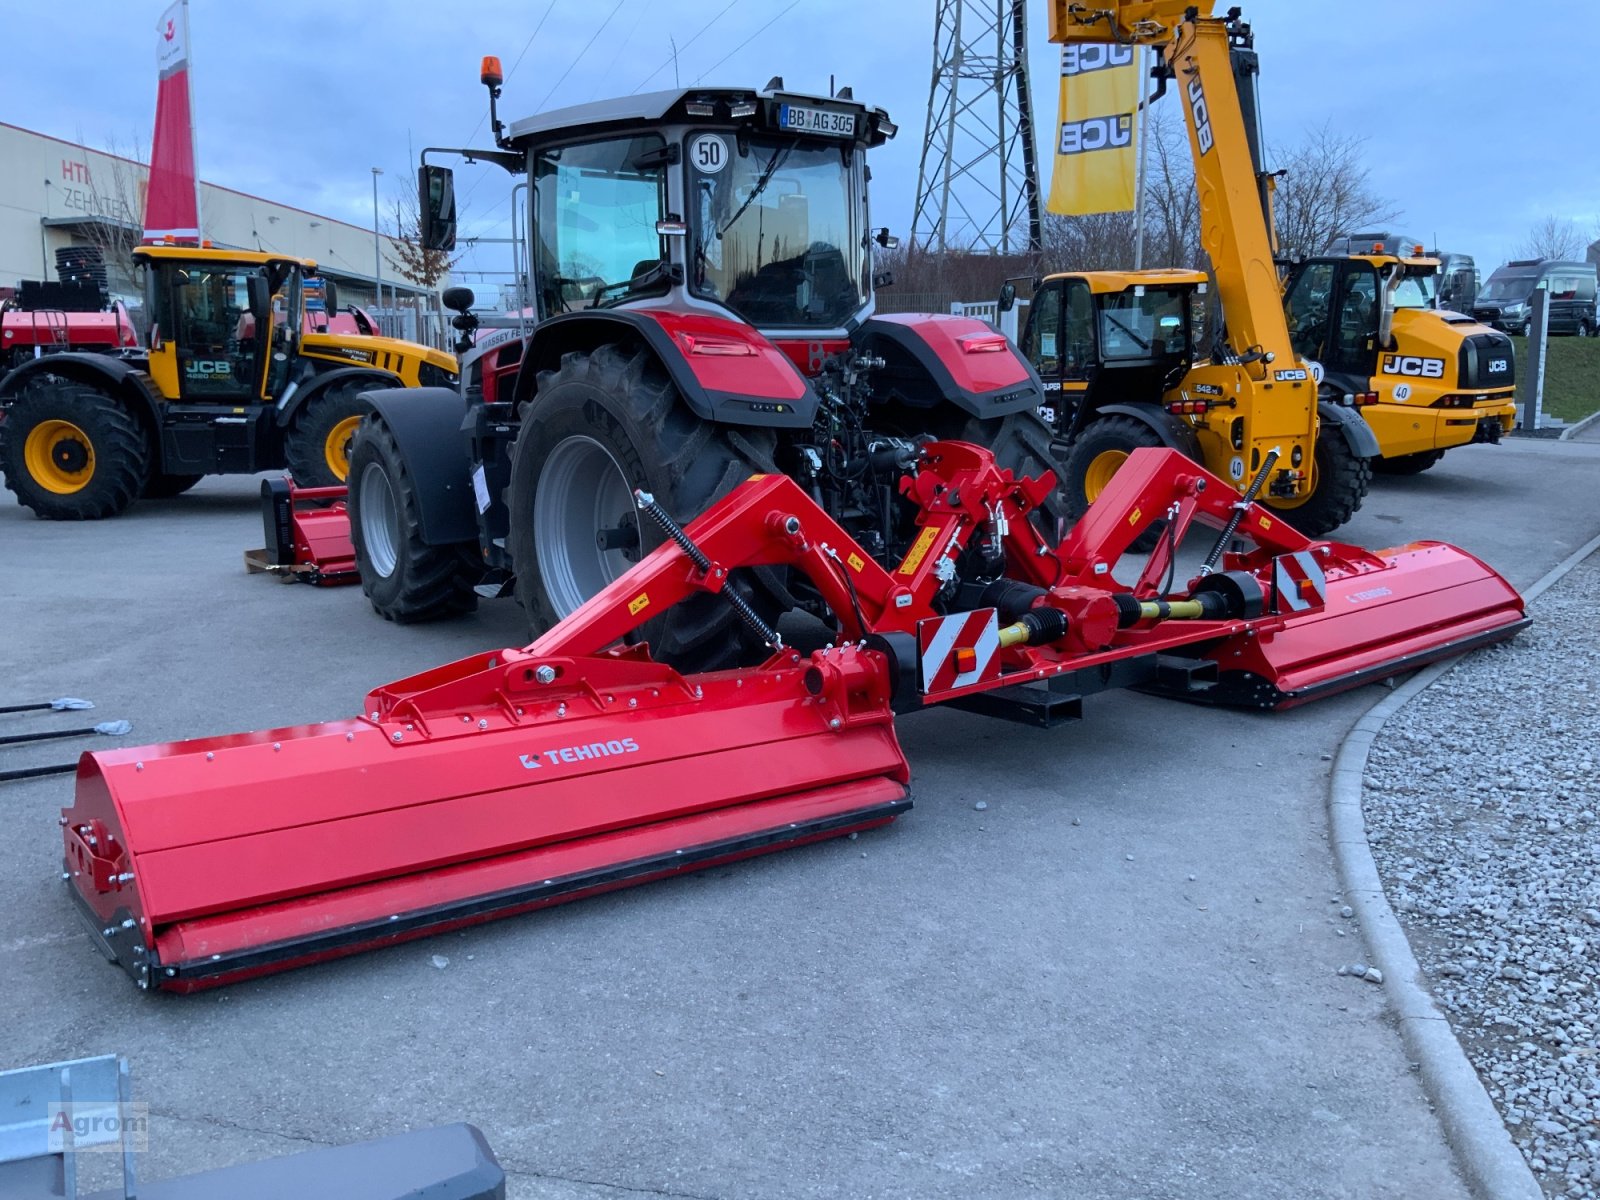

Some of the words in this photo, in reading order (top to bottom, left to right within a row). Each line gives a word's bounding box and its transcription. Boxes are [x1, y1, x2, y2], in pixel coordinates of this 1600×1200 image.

[789, 109, 805, 126] BB
[813, 112, 829, 129] AG
[831, 115, 854, 132] 305
[1188, 81, 1213, 154] JCB
[699, 142, 720, 165] 50
[482, 331, 509, 349] MASSEY
[186, 361, 231, 374] JCB
[1275, 369, 1307, 381] JCB
[1383, 356, 1444, 378] JCB
[1489, 360, 1507, 372] JCB
[1396, 387, 1408, 399] 40
[1232, 461, 1242, 476] 40
[543, 738, 640, 765] TEHNOS
